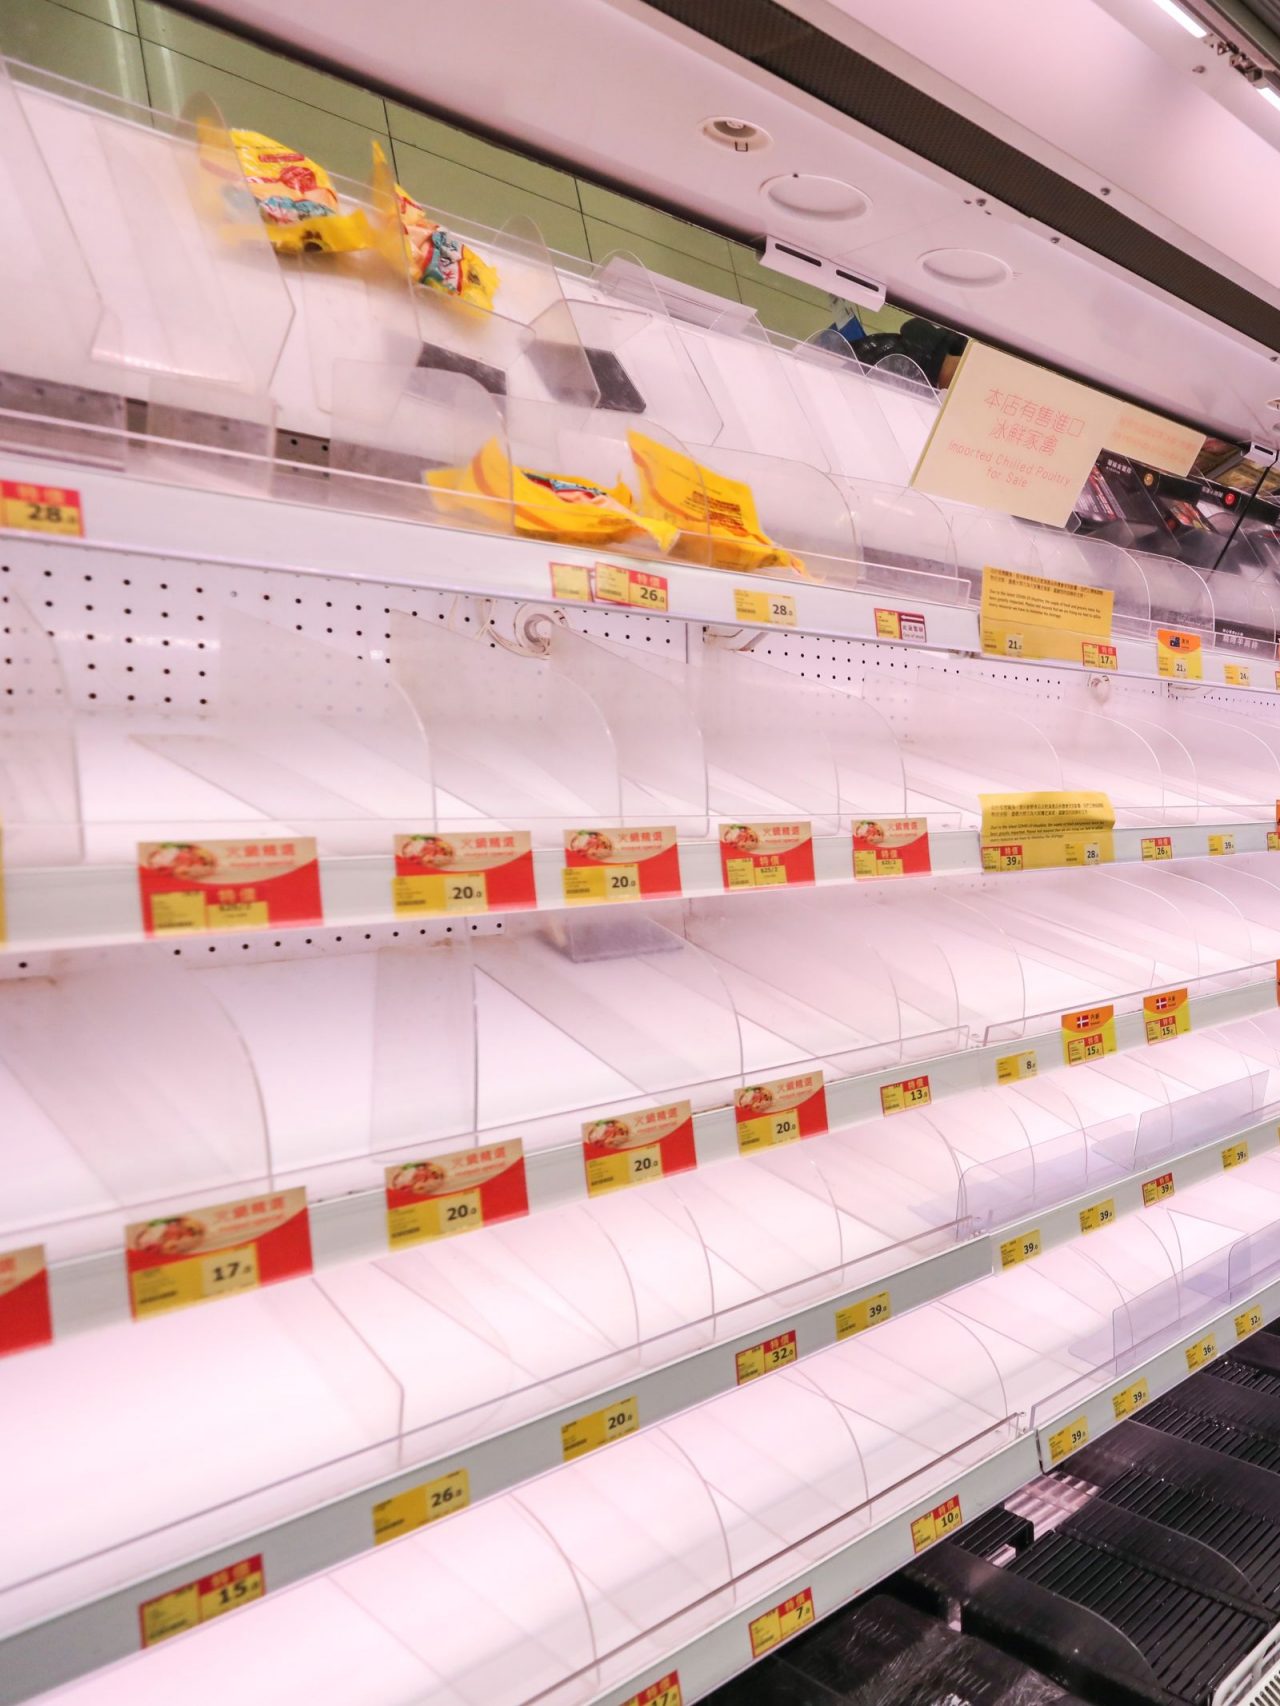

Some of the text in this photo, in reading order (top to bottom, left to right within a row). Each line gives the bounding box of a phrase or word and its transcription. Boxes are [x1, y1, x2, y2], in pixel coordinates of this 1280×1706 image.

[984, 388, 1085, 437] 本店有售進口
[995, 453, 1033, 473] Chilled
[1035, 466, 1071, 487] Poultry
[1006, 472, 1028, 488] Sale
